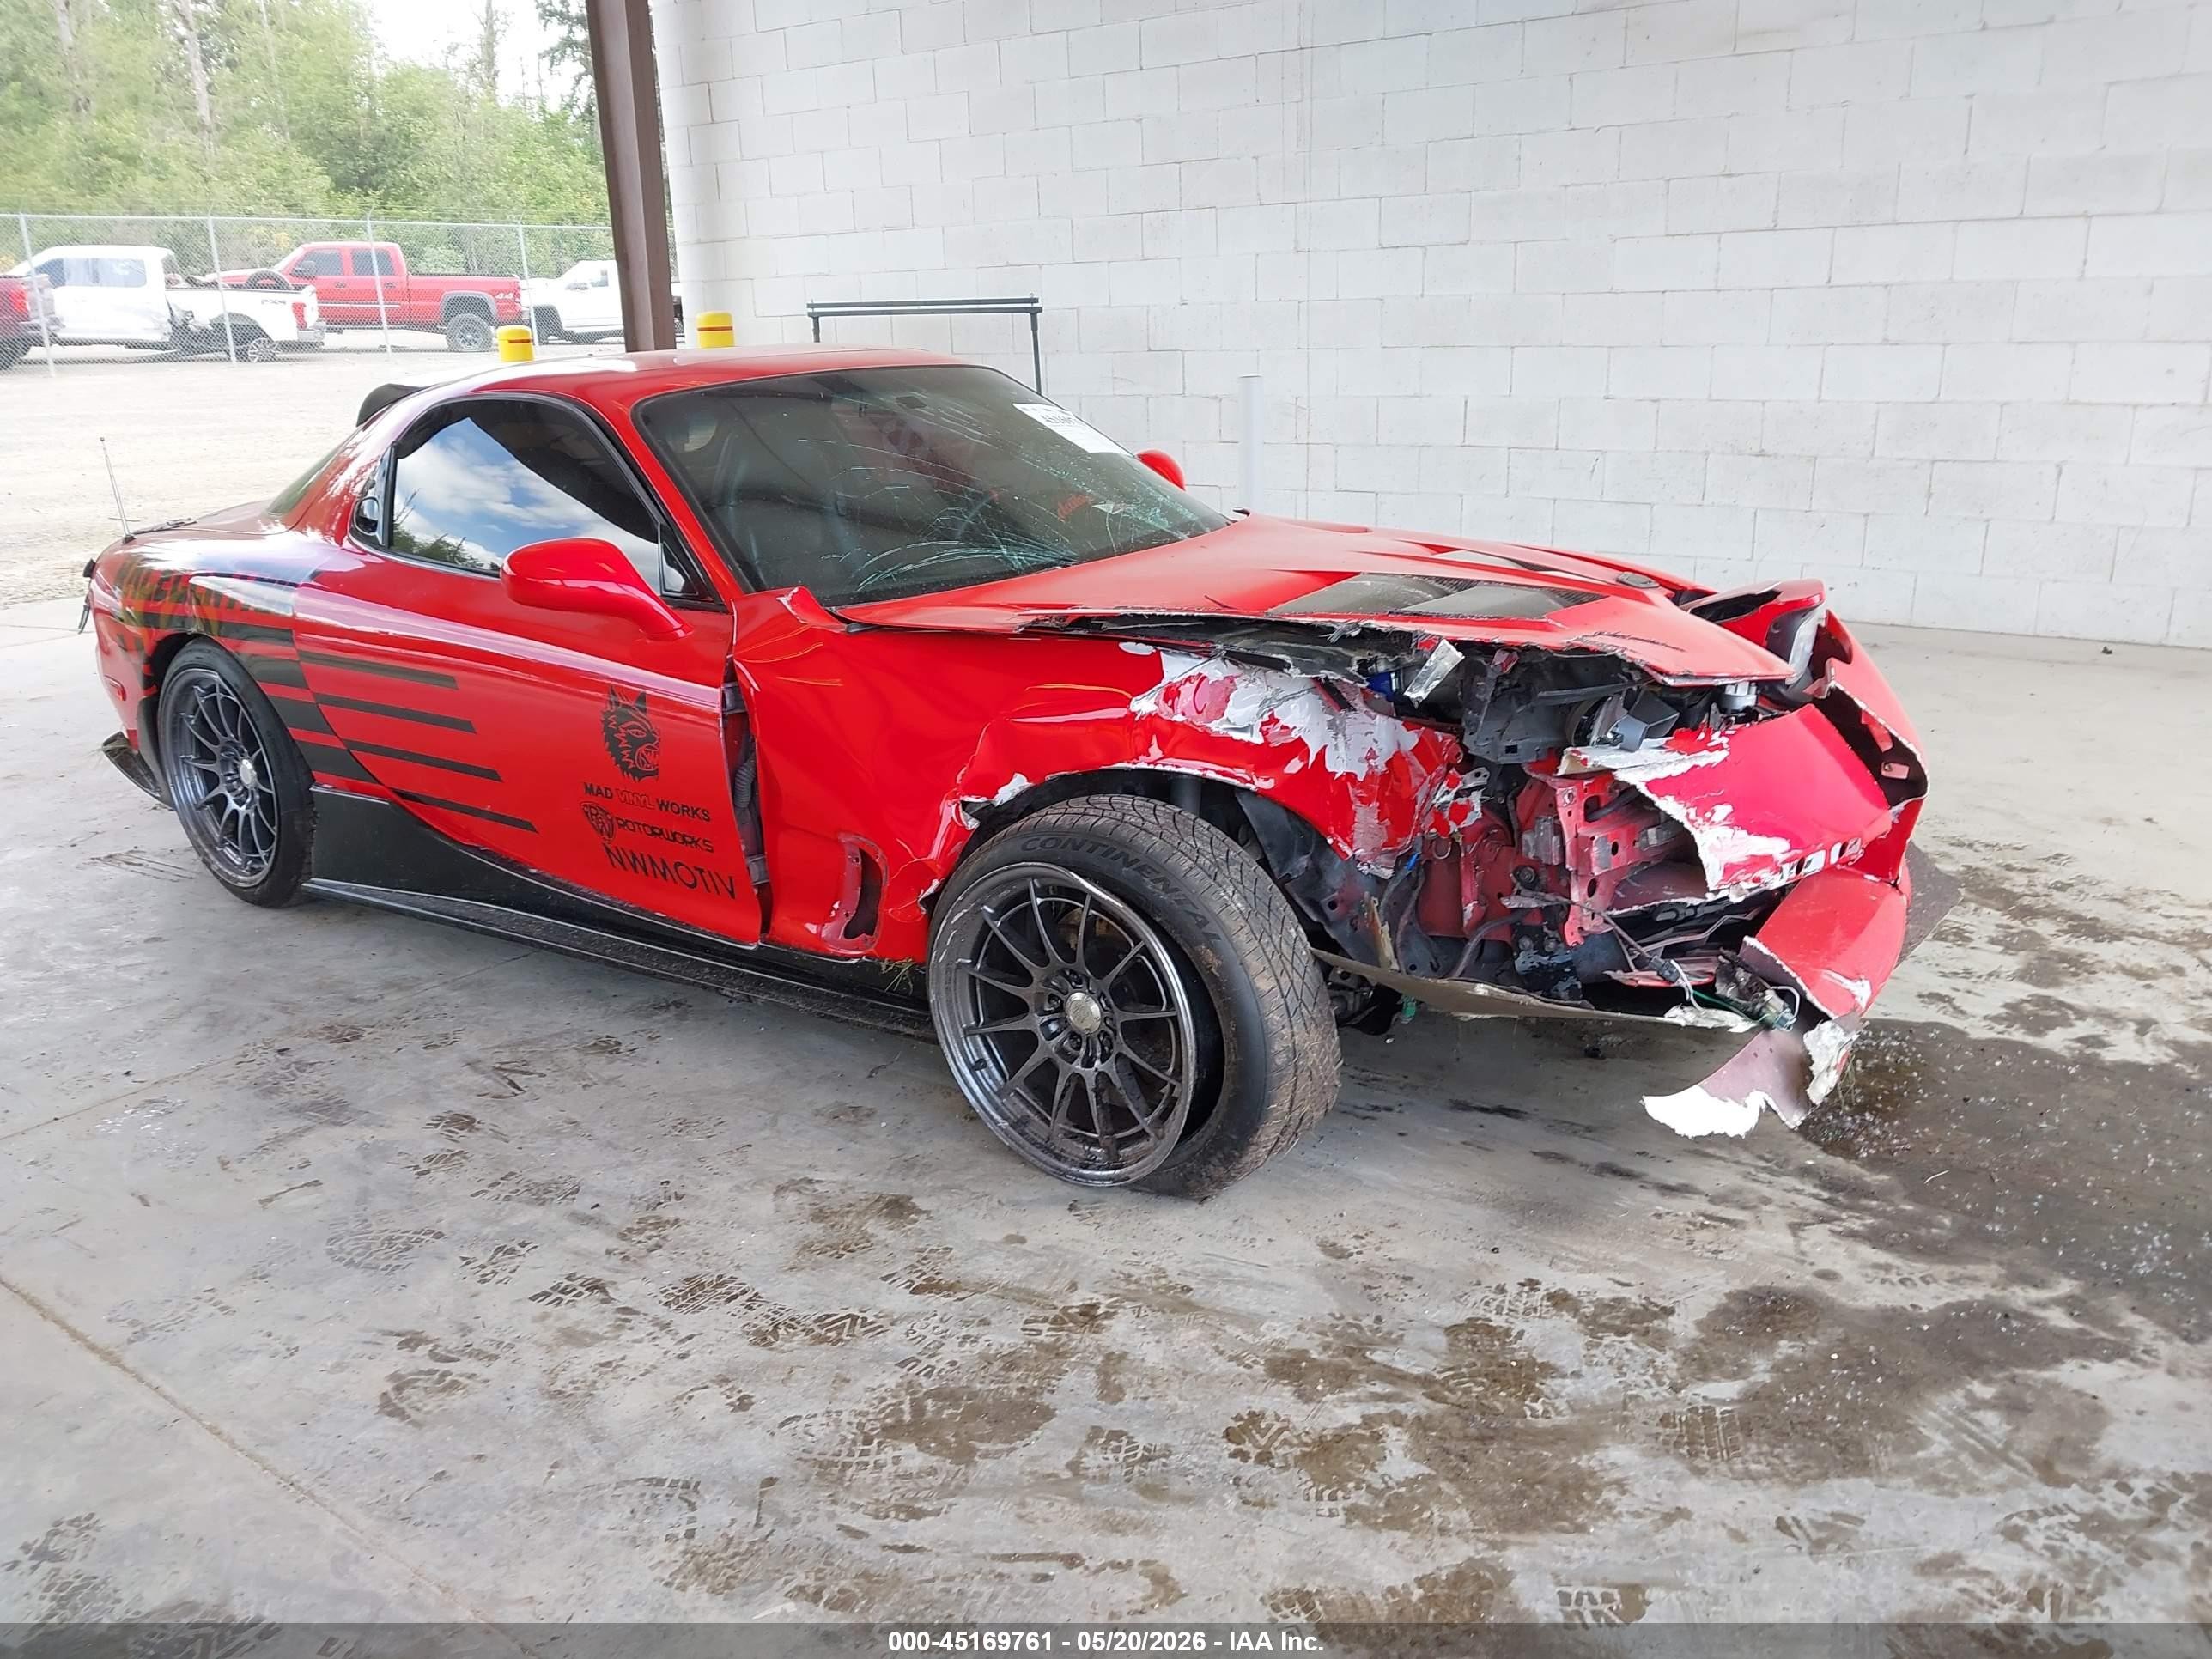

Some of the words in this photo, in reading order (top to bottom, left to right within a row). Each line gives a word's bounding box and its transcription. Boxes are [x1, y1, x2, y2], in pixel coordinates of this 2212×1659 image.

[583, 782, 613, 799] MAD
[617, 789, 655, 810] VINYL
[656, 798, 710, 822] WORKS
[615, 817, 714, 854] ROTORWORKS
[603, 843, 736, 899] NWMOTIV
[1021, 836, 1222, 942] CONTINENTAL
